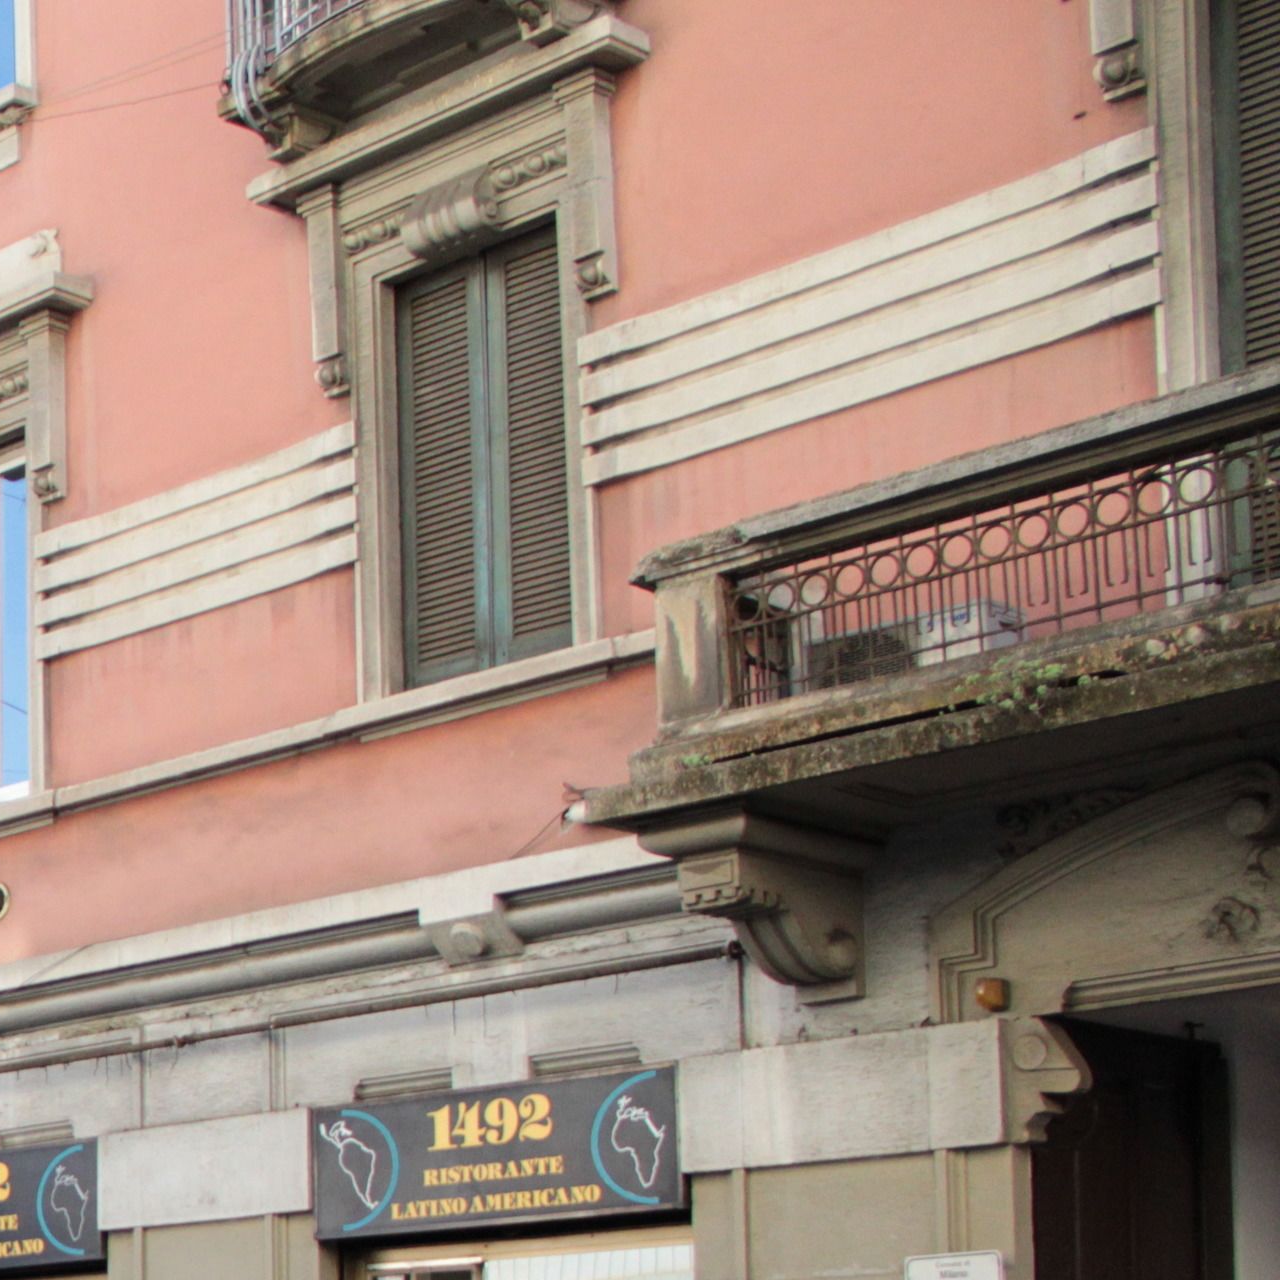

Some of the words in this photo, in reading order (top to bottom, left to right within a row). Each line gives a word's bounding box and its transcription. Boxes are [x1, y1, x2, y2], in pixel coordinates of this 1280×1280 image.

[426, 1093, 553, 1151] 1492
[423, 1155, 564, 1187] RISTORANTE
[391, 1196, 468, 1220] LATINO
[470, 1184, 602, 1213] AMERICANO
